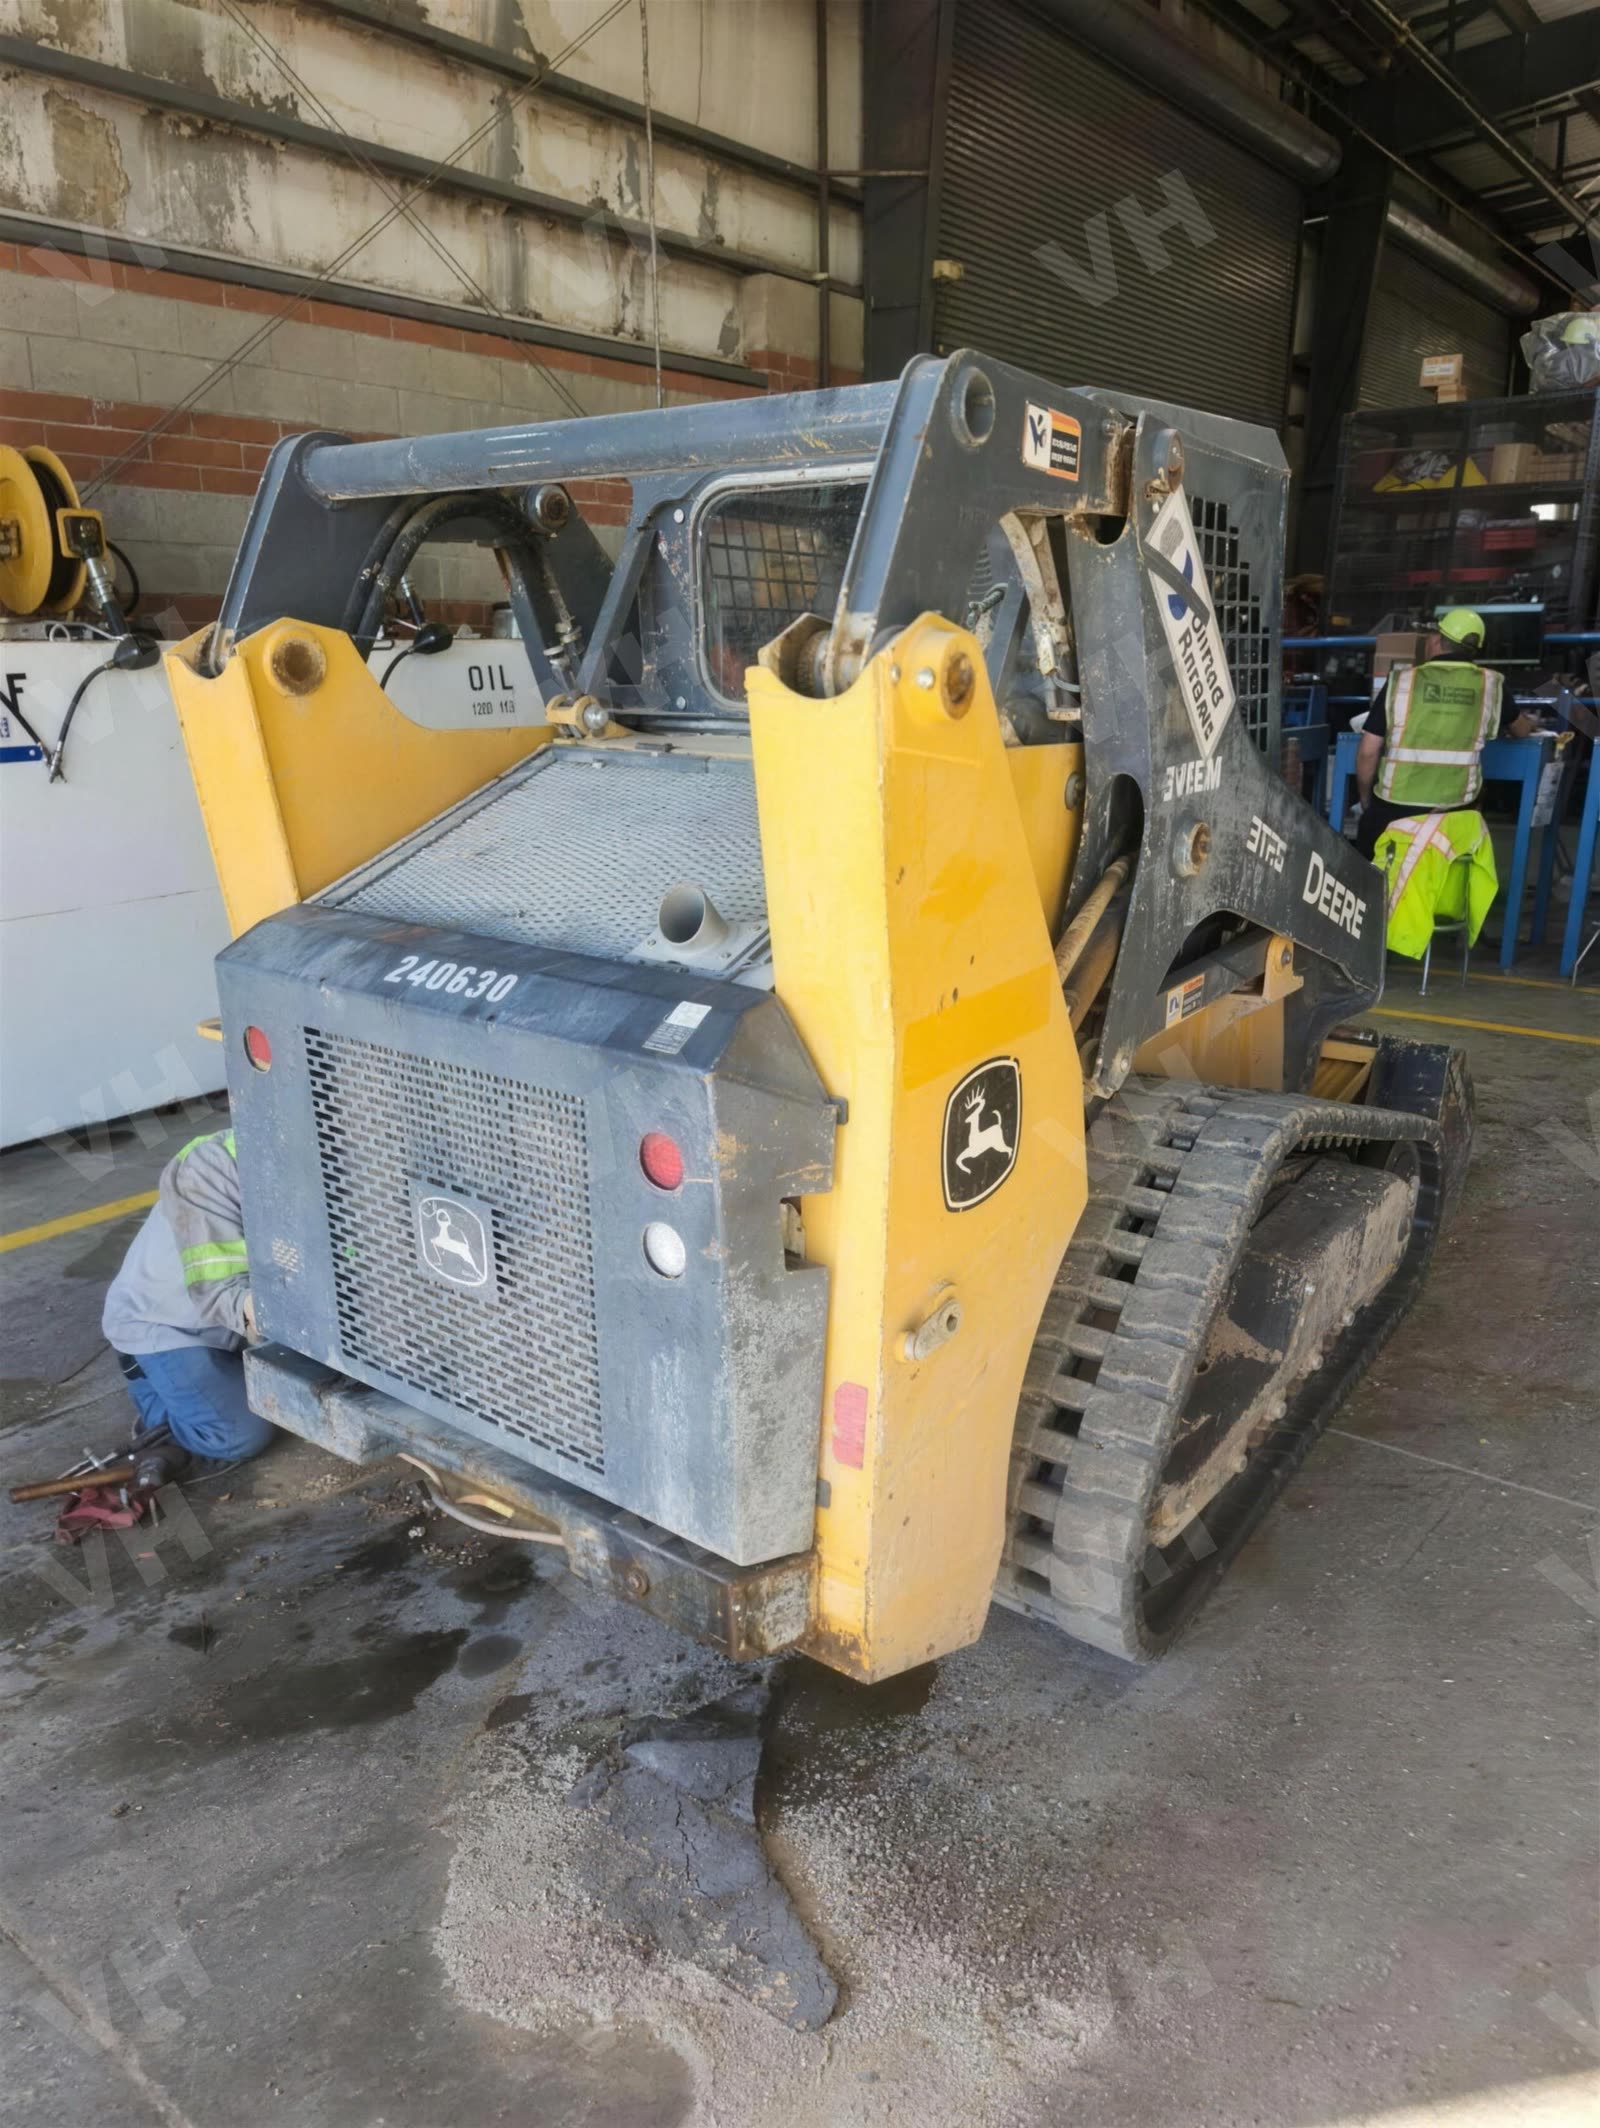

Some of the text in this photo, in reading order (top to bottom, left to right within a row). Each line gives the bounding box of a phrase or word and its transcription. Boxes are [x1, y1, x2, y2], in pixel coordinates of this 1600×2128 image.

[468, 664, 514, 692] OIL
[1302, 850, 1367, 940] DEERE
[383, 955, 519, 1003] 240630
